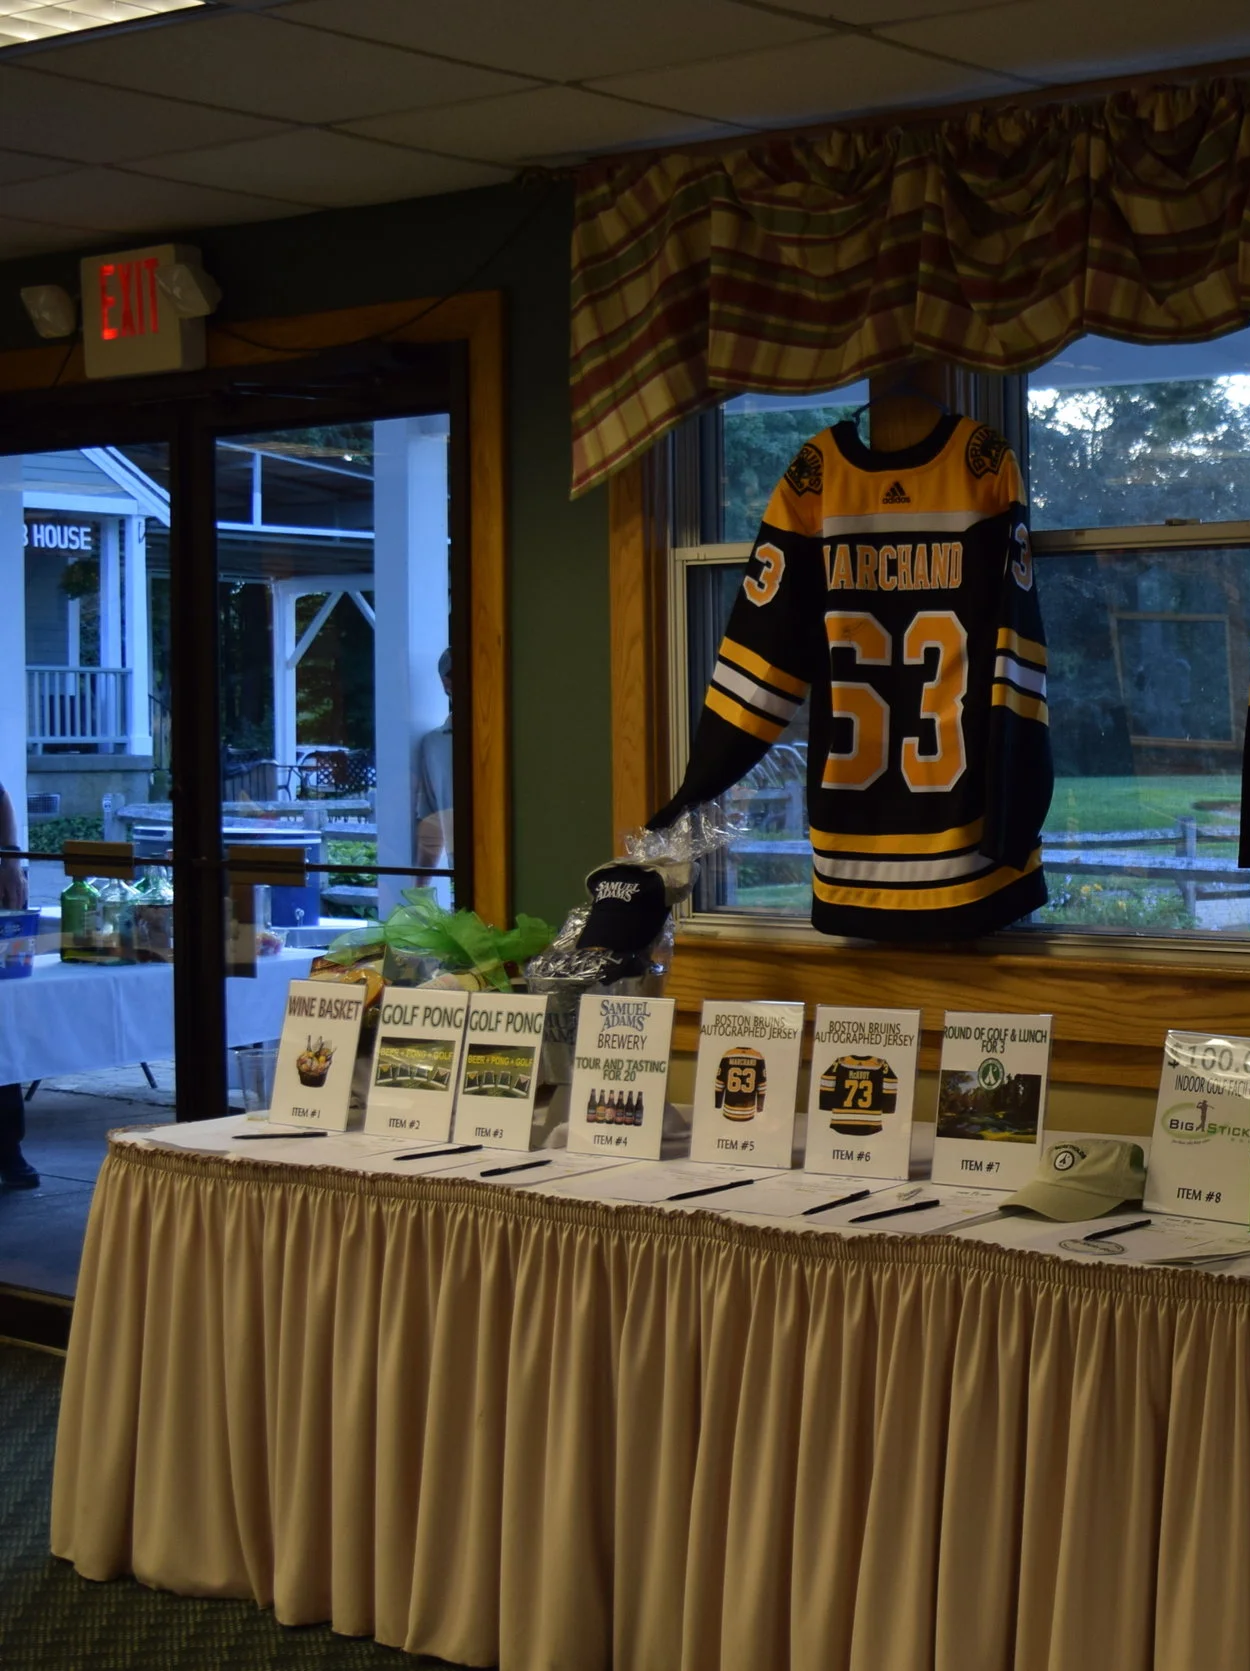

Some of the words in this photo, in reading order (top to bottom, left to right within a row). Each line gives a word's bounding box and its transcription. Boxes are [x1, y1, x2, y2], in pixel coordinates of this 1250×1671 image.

[100, 258, 159, 340] EXIT
[32, 523, 93, 550] HOUSE
[742, 541, 787, 608] 3
[595, 880, 641, 894] SAMUEL
[596, 889, 633, 904] ADAMS
[288, 995, 316, 1018] WINE
[317, 998, 362, 1021] BASKET
[600, 999, 651, 1017] SAMUEL
[381, 1004, 419, 1026] GOLF
[422, 1006, 464, 1029] PONG
[469, 1009, 503, 1032] GOLF
[505, 1011, 543, 1034] PONG
[601, 1014, 644, 1032] ADAMS
[715, 1014, 750, 1028] BOSTON
[753, 1015, 786, 1029] BRUINS
[700, 1024, 767, 1039] AUTOGRAPHED
[768, 1026, 798, 1040] JERSEY
[828, 1020, 866, 1034] BOSTON
[868, 1021, 901, 1035] BRUINS
[974, 1027, 986, 1041] OF
[986, 1027, 1009, 1043] GOLF
[1010, 1029, 1017, 1042] &
[1018, 1029, 1048, 1043] LUNCH
[597, 1033, 648, 1050] BREWERY
[814, 1031, 883, 1045] AUTOGRAPHED
[883, 1033, 915, 1047] JERSEY
[981, 1040, 998, 1053] FOR
[999, 1041, 1006, 1054] 3
[576, 1056, 600, 1070] TOUR
[602, 1058, 625, 1071] AND
[625, 1059, 666, 1074] TASTING
[603, 1069, 622, 1081] FOR
[623, 1070, 636, 1082] 20
[727, 1067, 757, 1093] 63
[1175, 1074, 1206, 1093] INDOOR
[842, 1080, 874, 1108] 73
[291, 1107, 309, 1118] ITEM
[310, 1109, 321, 1119] #1
[388, 1118, 407, 1130] ITEM
[408, 1119, 420, 1130] #2
[1169, 1118, 1194, 1132] BIG
[1207, 1122, 1250, 1138] STICK
[475, 1127, 491, 1138] ITEM
[492, 1128, 504, 1139] #3
[593, 1135, 613, 1146] ITEM
[615, 1136, 628, 1147] #4
[717, 1138, 738, 1151] ITEM
[741, 1140, 755, 1151] #5
[832, 1149, 854, 1161] ITEM
[857, 1150, 871, 1162] #6
[961, 1159, 983, 1172] ITEM
[986, 1161, 1001, 1173] #7
[1176, 1187, 1202, 1201] ITEM
[1205, 1191, 1222, 1203] #8
